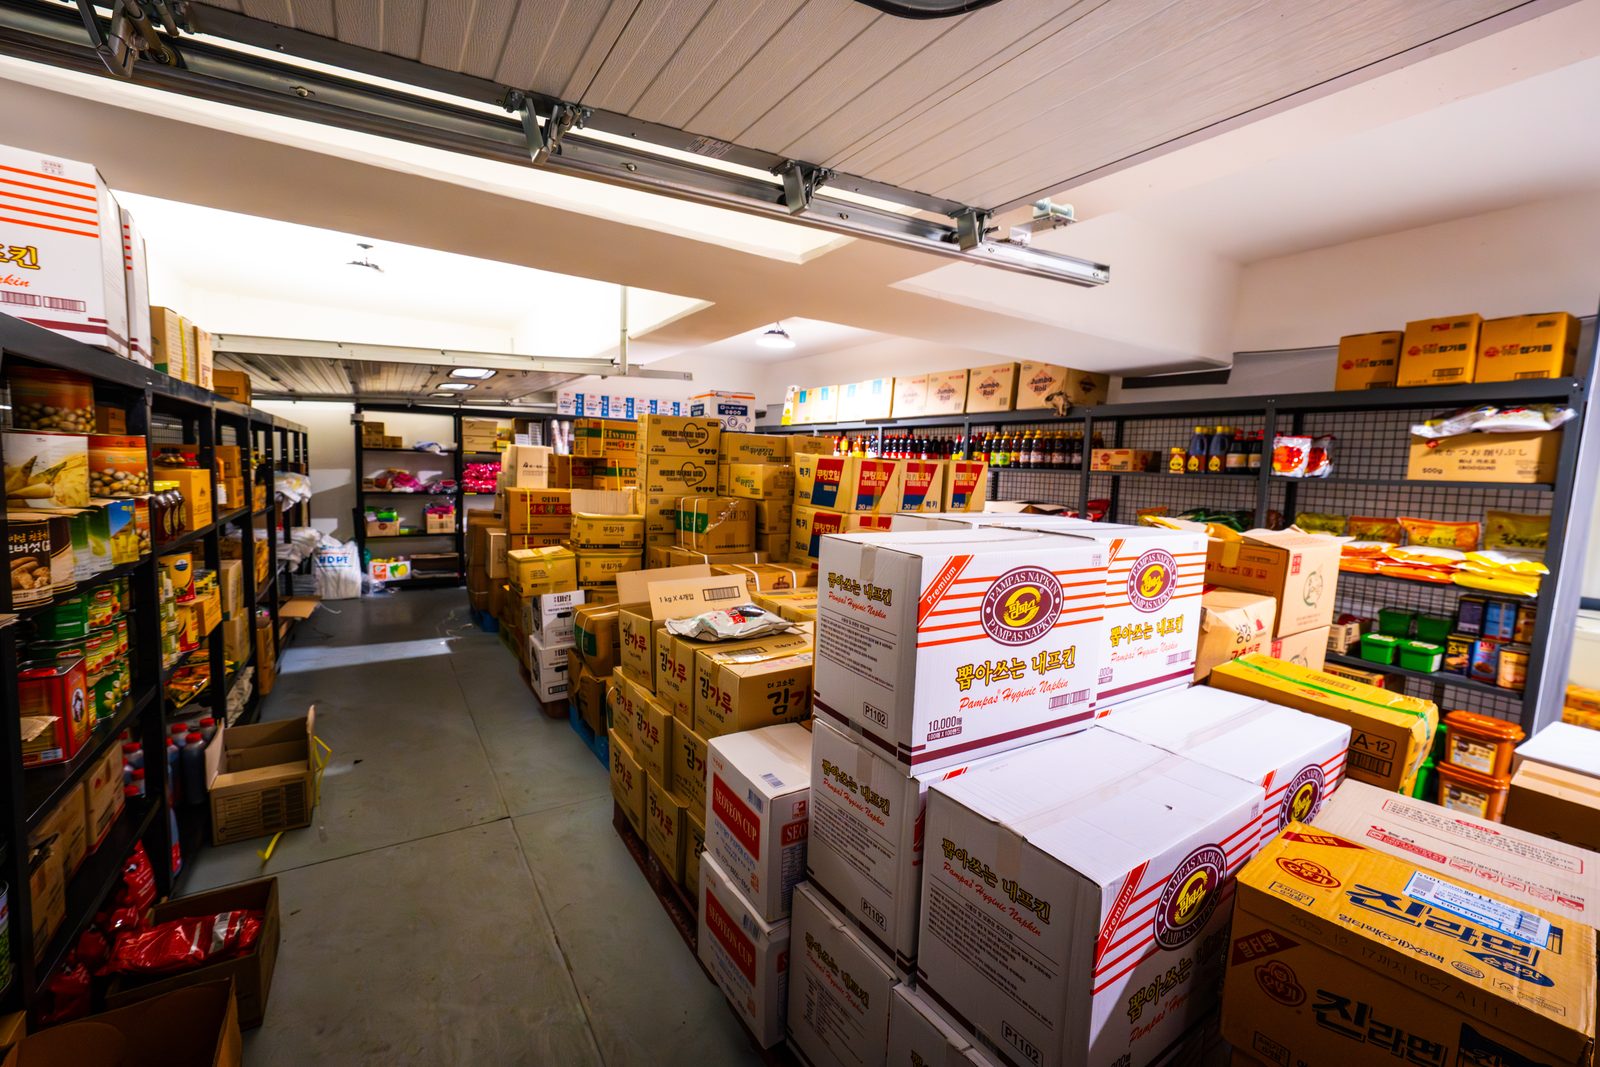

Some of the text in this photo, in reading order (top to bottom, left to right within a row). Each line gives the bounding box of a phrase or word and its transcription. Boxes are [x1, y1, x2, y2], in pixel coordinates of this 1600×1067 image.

[979, 382, 1000, 390] Jumbo
[1030, 376, 1053, 386] Jumbo
[1033, 384, 1047, 392] Roll
[603, 429, 636, 440] Hwam
[816, 469, 841, 482] 쿠킹호일
[1422, 467, 1444, 475] 500g
[602, 525, 625, 533] 부침가루
[1132, 553, 1156, 577] PAMPAS
[827, 572, 893, 607] 뽑아쓰는 내프킨
[926, 566, 962, 605] Premium
[989, 571, 1059, 602] PAMPAS NAPKIN
[866, 604, 887, 619] Napkin
[987, 610, 1058, 642] PAMPAS NAPKIN
[622, 627, 647, 653] 김가루
[1110, 613, 1185, 648] 뽑아쓰는 내프킨
[659, 651, 687, 685] 김가루
[956, 645, 1076, 692] 뽑아쓰는 내프킨
[615, 686, 635, 717] 김가루
[700, 676, 733, 715] 김가루
[1001, 686, 1037, 705] Hyginic
[1039, 678, 1069, 693] Napkin
[636, 709, 660, 746] 김가루
[865, 704, 887, 725] P1102
[928, 716, 963, 733] 10.000매
[1353, 733, 1391, 755] A-12
[613, 750, 634, 791] 김가루
[822, 758, 858, 794] 뽑아쓰는
[649, 793, 674, 837] 김가루
[714, 787, 743, 828] SEOYEON
[742, 818, 757, 842] CUP
[864, 806, 886, 828] Napkin
[942, 837, 998, 889] 뽑아쓰는
[1002, 877, 1052, 925] 내프킨
[1161, 851, 1224, 907] PAMPAS NAPKIN
[862, 900, 885, 928] P1102
[975, 883, 1008, 914] Hyginic
[1008, 906, 1041, 938] Napkin
[1102, 882, 1135, 941] Premium
[1345, 882, 1541, 967] 진라면
[708, 902, 738, 949] SEOYEON
[737, 940, 753, 967] CUP
[1477, 950, 1544, 984] 순한맛
[1127, 957, 1193, 1025] 뽑아쓰는
[1311, 988, 1450, 1067] 진라면
[1004, 1025, 1039, 1066] P1102
